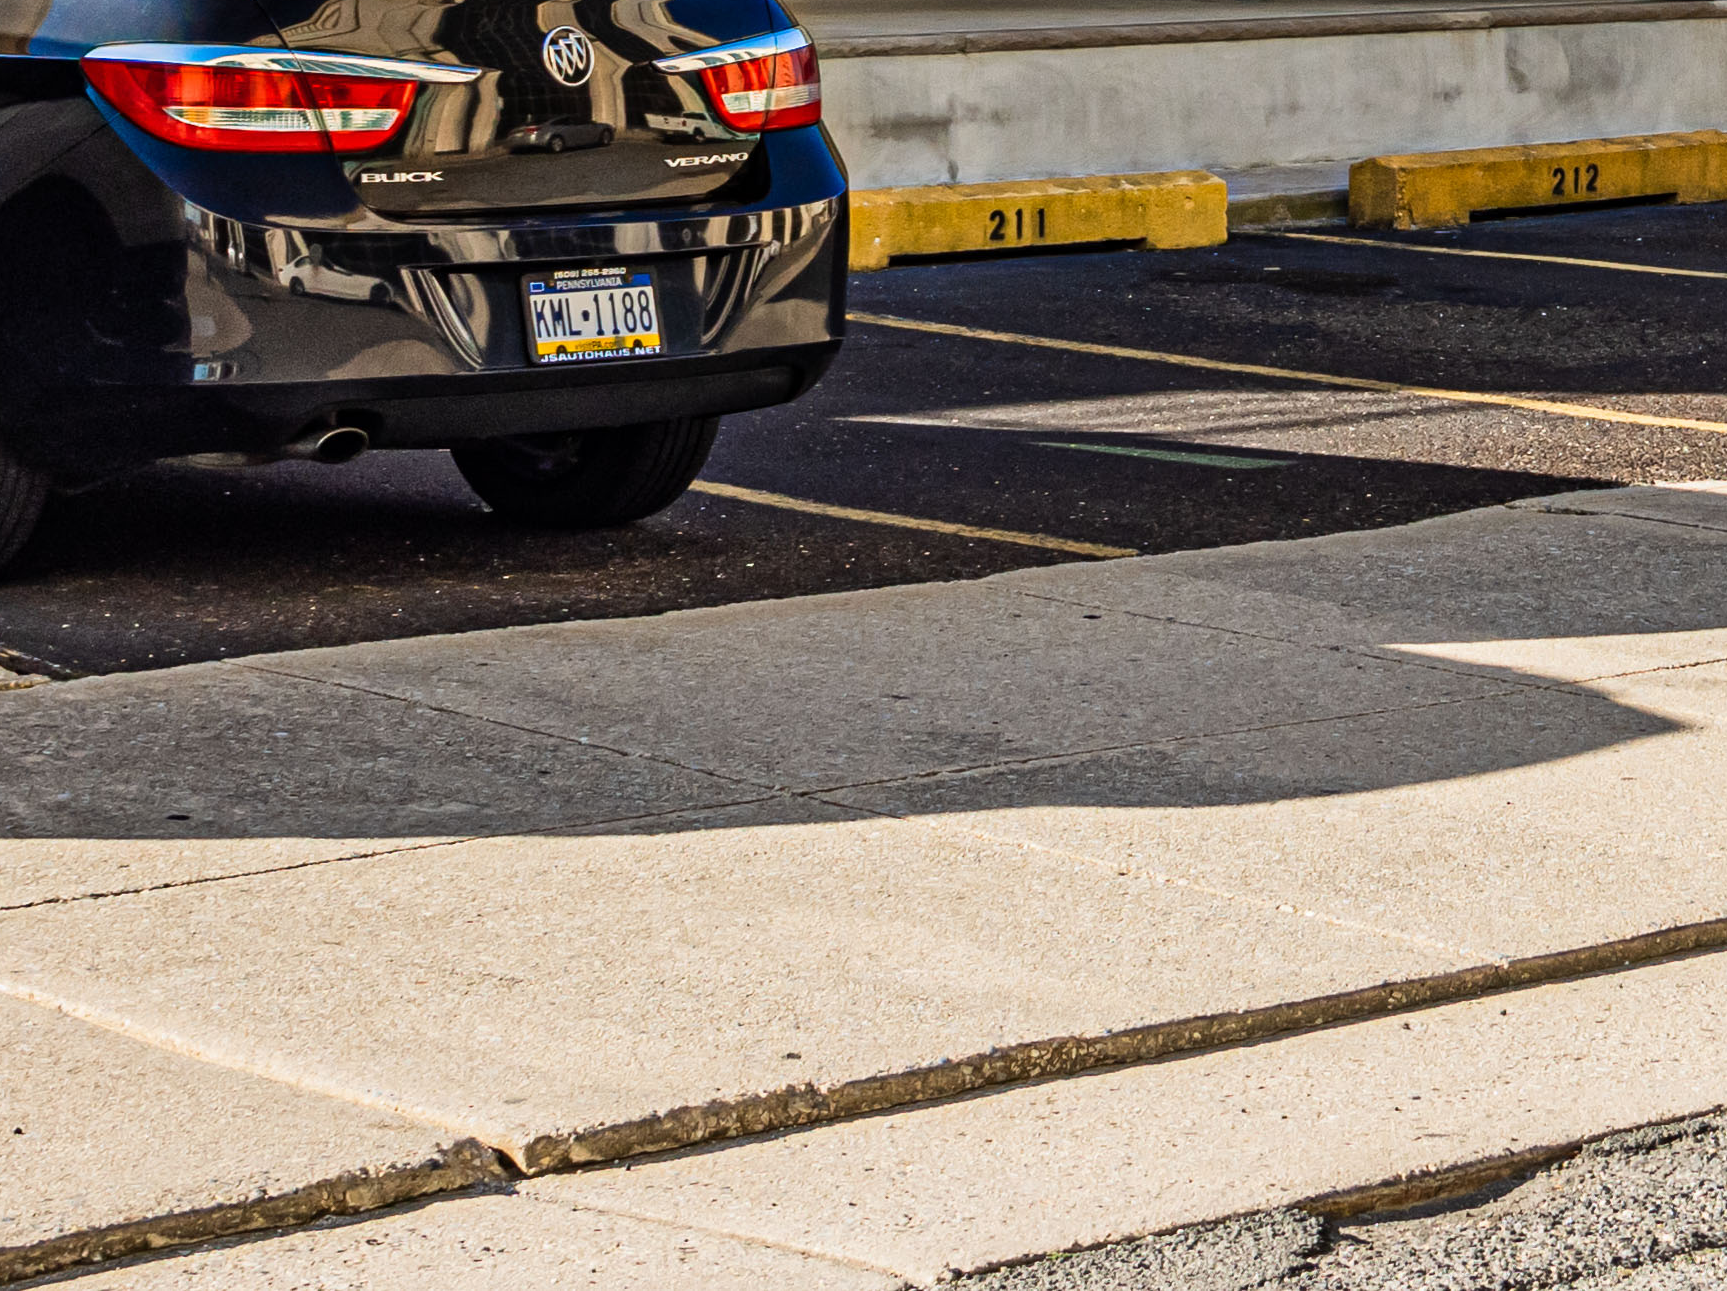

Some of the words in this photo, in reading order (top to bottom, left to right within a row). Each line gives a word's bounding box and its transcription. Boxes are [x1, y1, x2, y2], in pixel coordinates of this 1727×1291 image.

[664, 151, 749, 168] VERANO
[361, 170, 444, 184] BUICK
[1553, 164, 1599, 195] 212
[989, 208, 1045, 241] 211
[556, 277, 623, 290] PENNSYLVANIA
